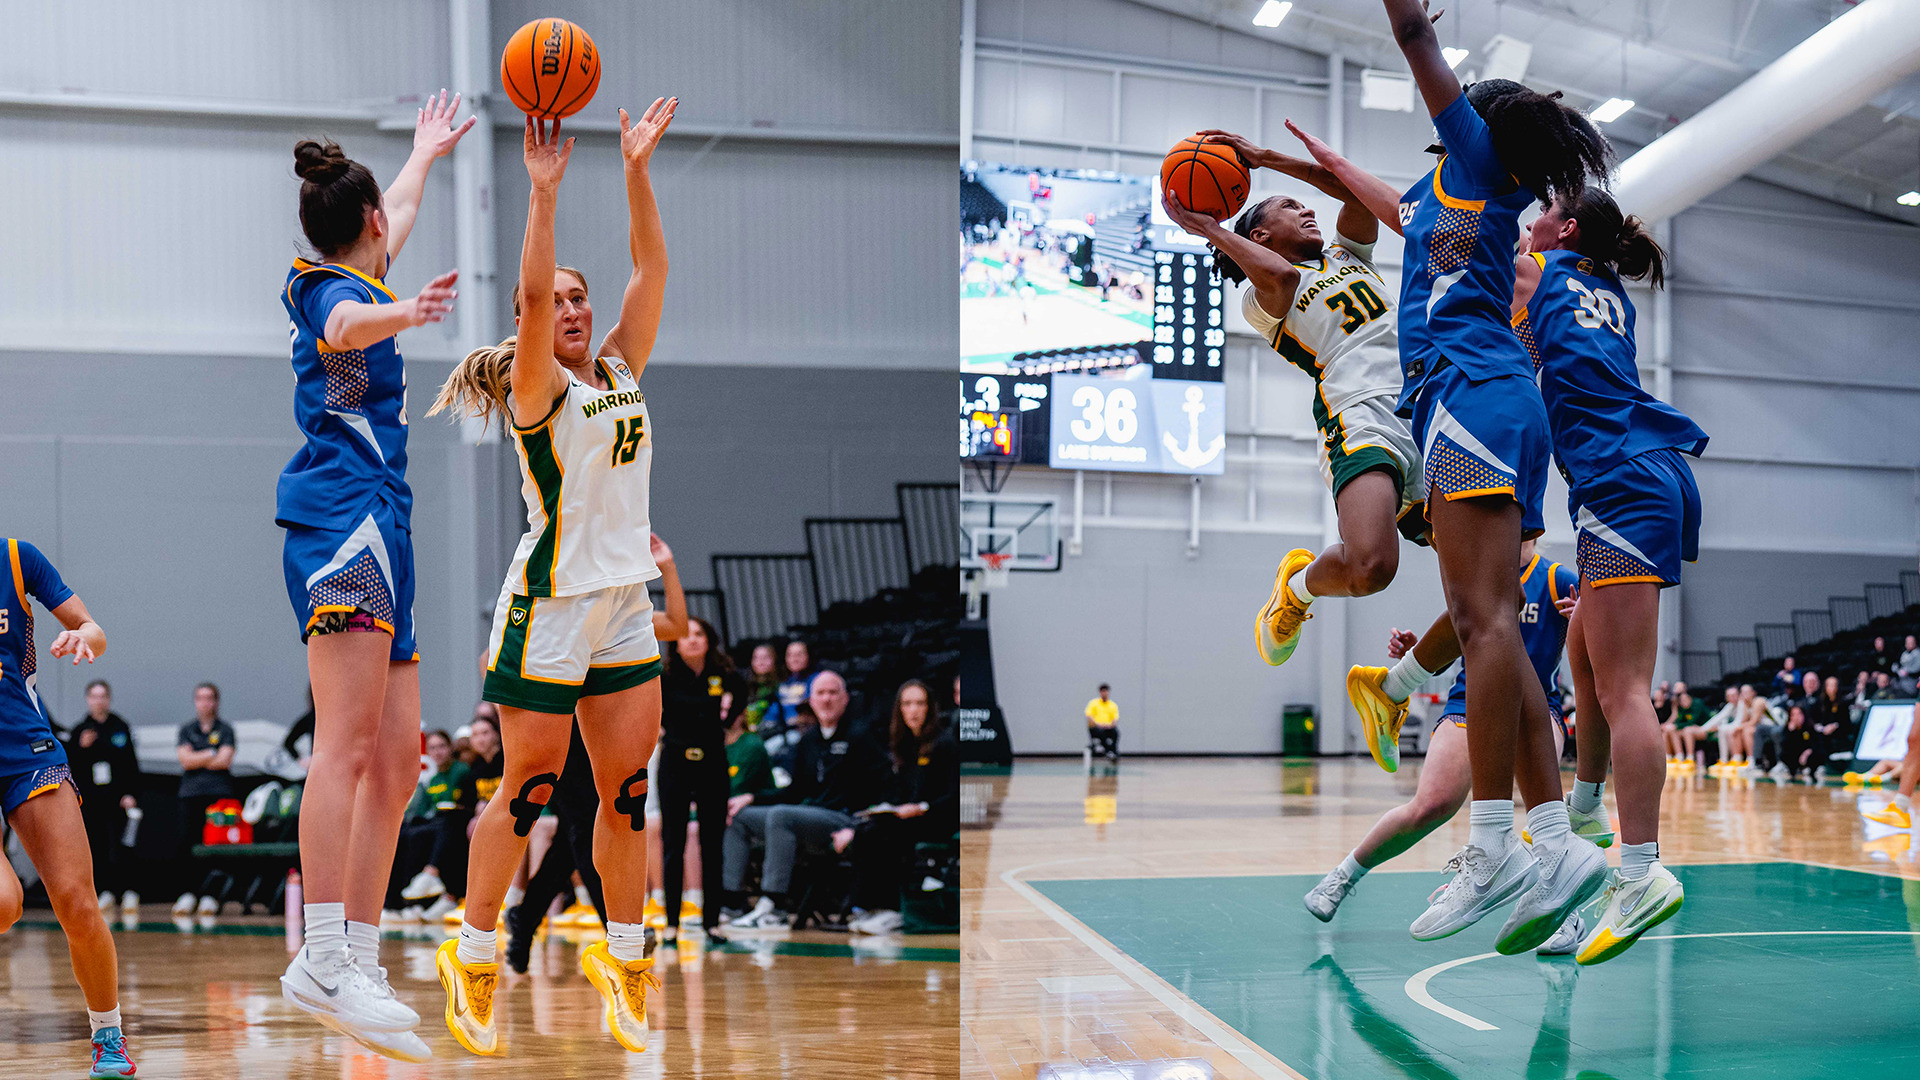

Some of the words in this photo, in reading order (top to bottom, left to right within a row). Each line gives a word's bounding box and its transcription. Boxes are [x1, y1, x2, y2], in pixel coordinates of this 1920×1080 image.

[1324, 278, 1389, 336] 30
[1566, 277, 1626, 337] 30
[611, 414, 645, 469] 15
[1070, 385, 1138, 444] 36
